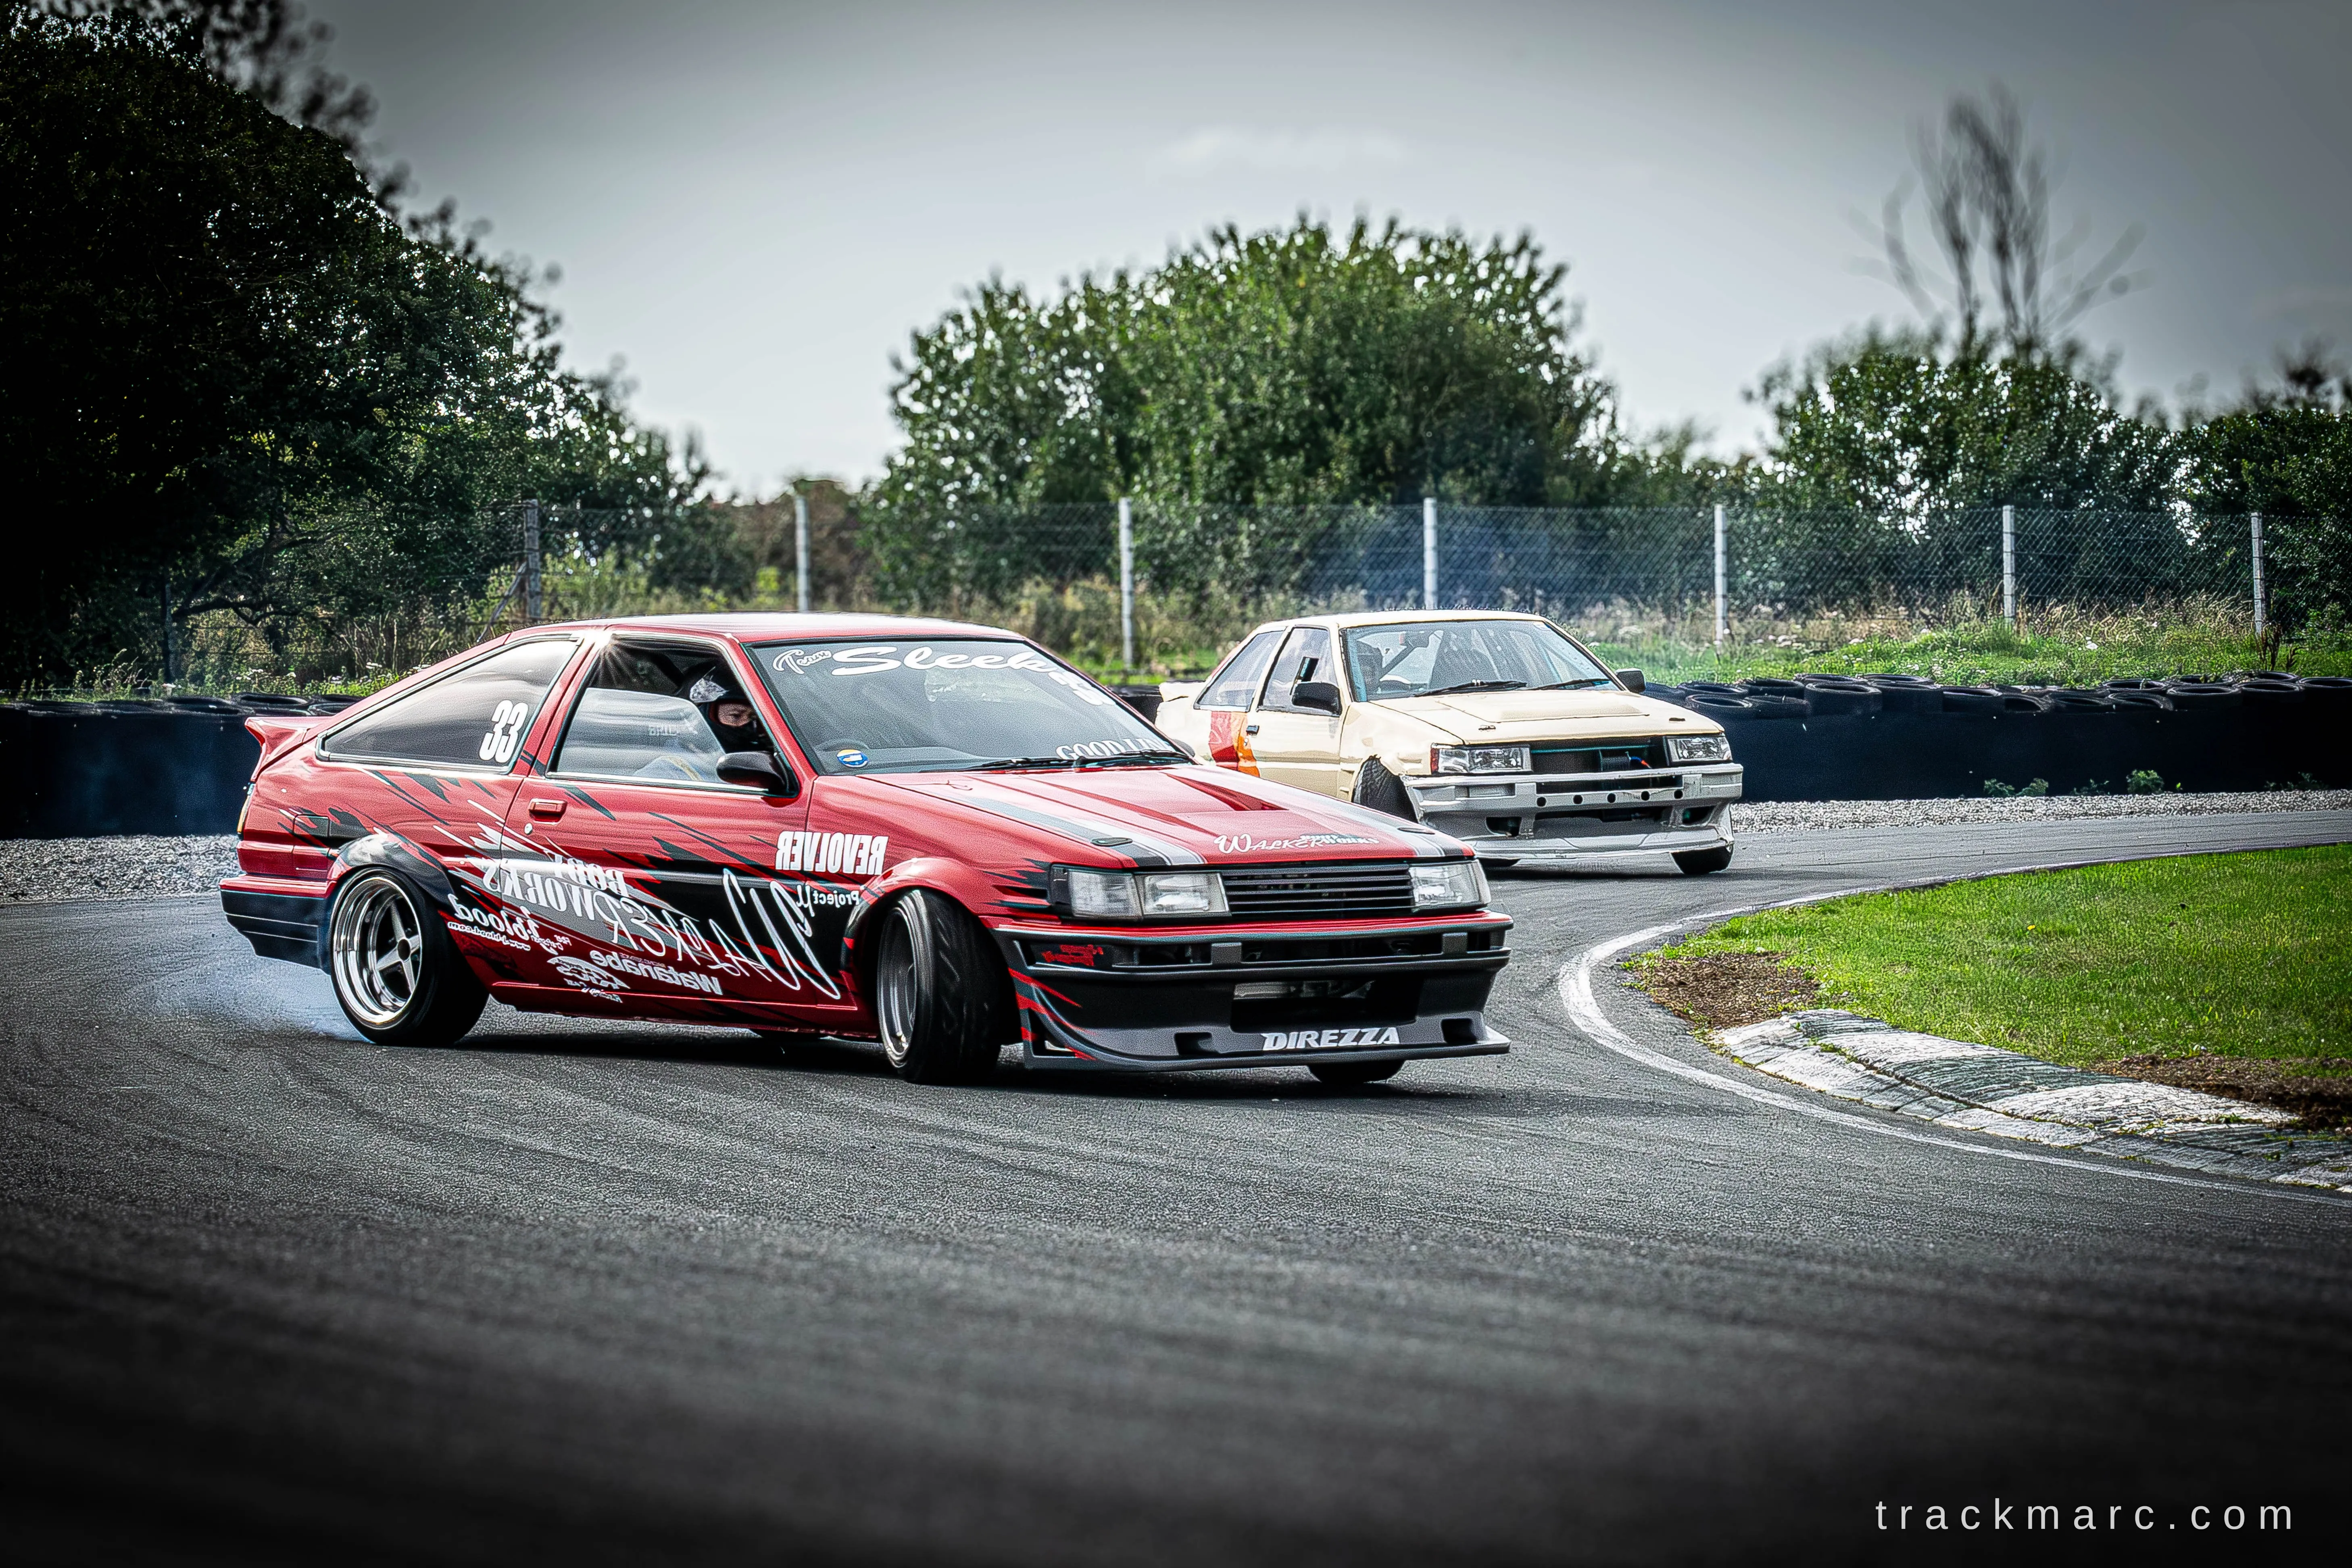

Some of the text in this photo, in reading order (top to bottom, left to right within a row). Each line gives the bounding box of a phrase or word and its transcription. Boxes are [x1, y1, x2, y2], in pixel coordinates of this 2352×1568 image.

[772, 648, 832, 675] Team
[831, 646, 1058, 676] Sleek
[479, 700, 528, 763] 33
[1056, 740, 1127, 760] GOOD
[1214, 833, 1324, 854] WALKER
[1260, 1027, 1400, 1051] DIREZZA
